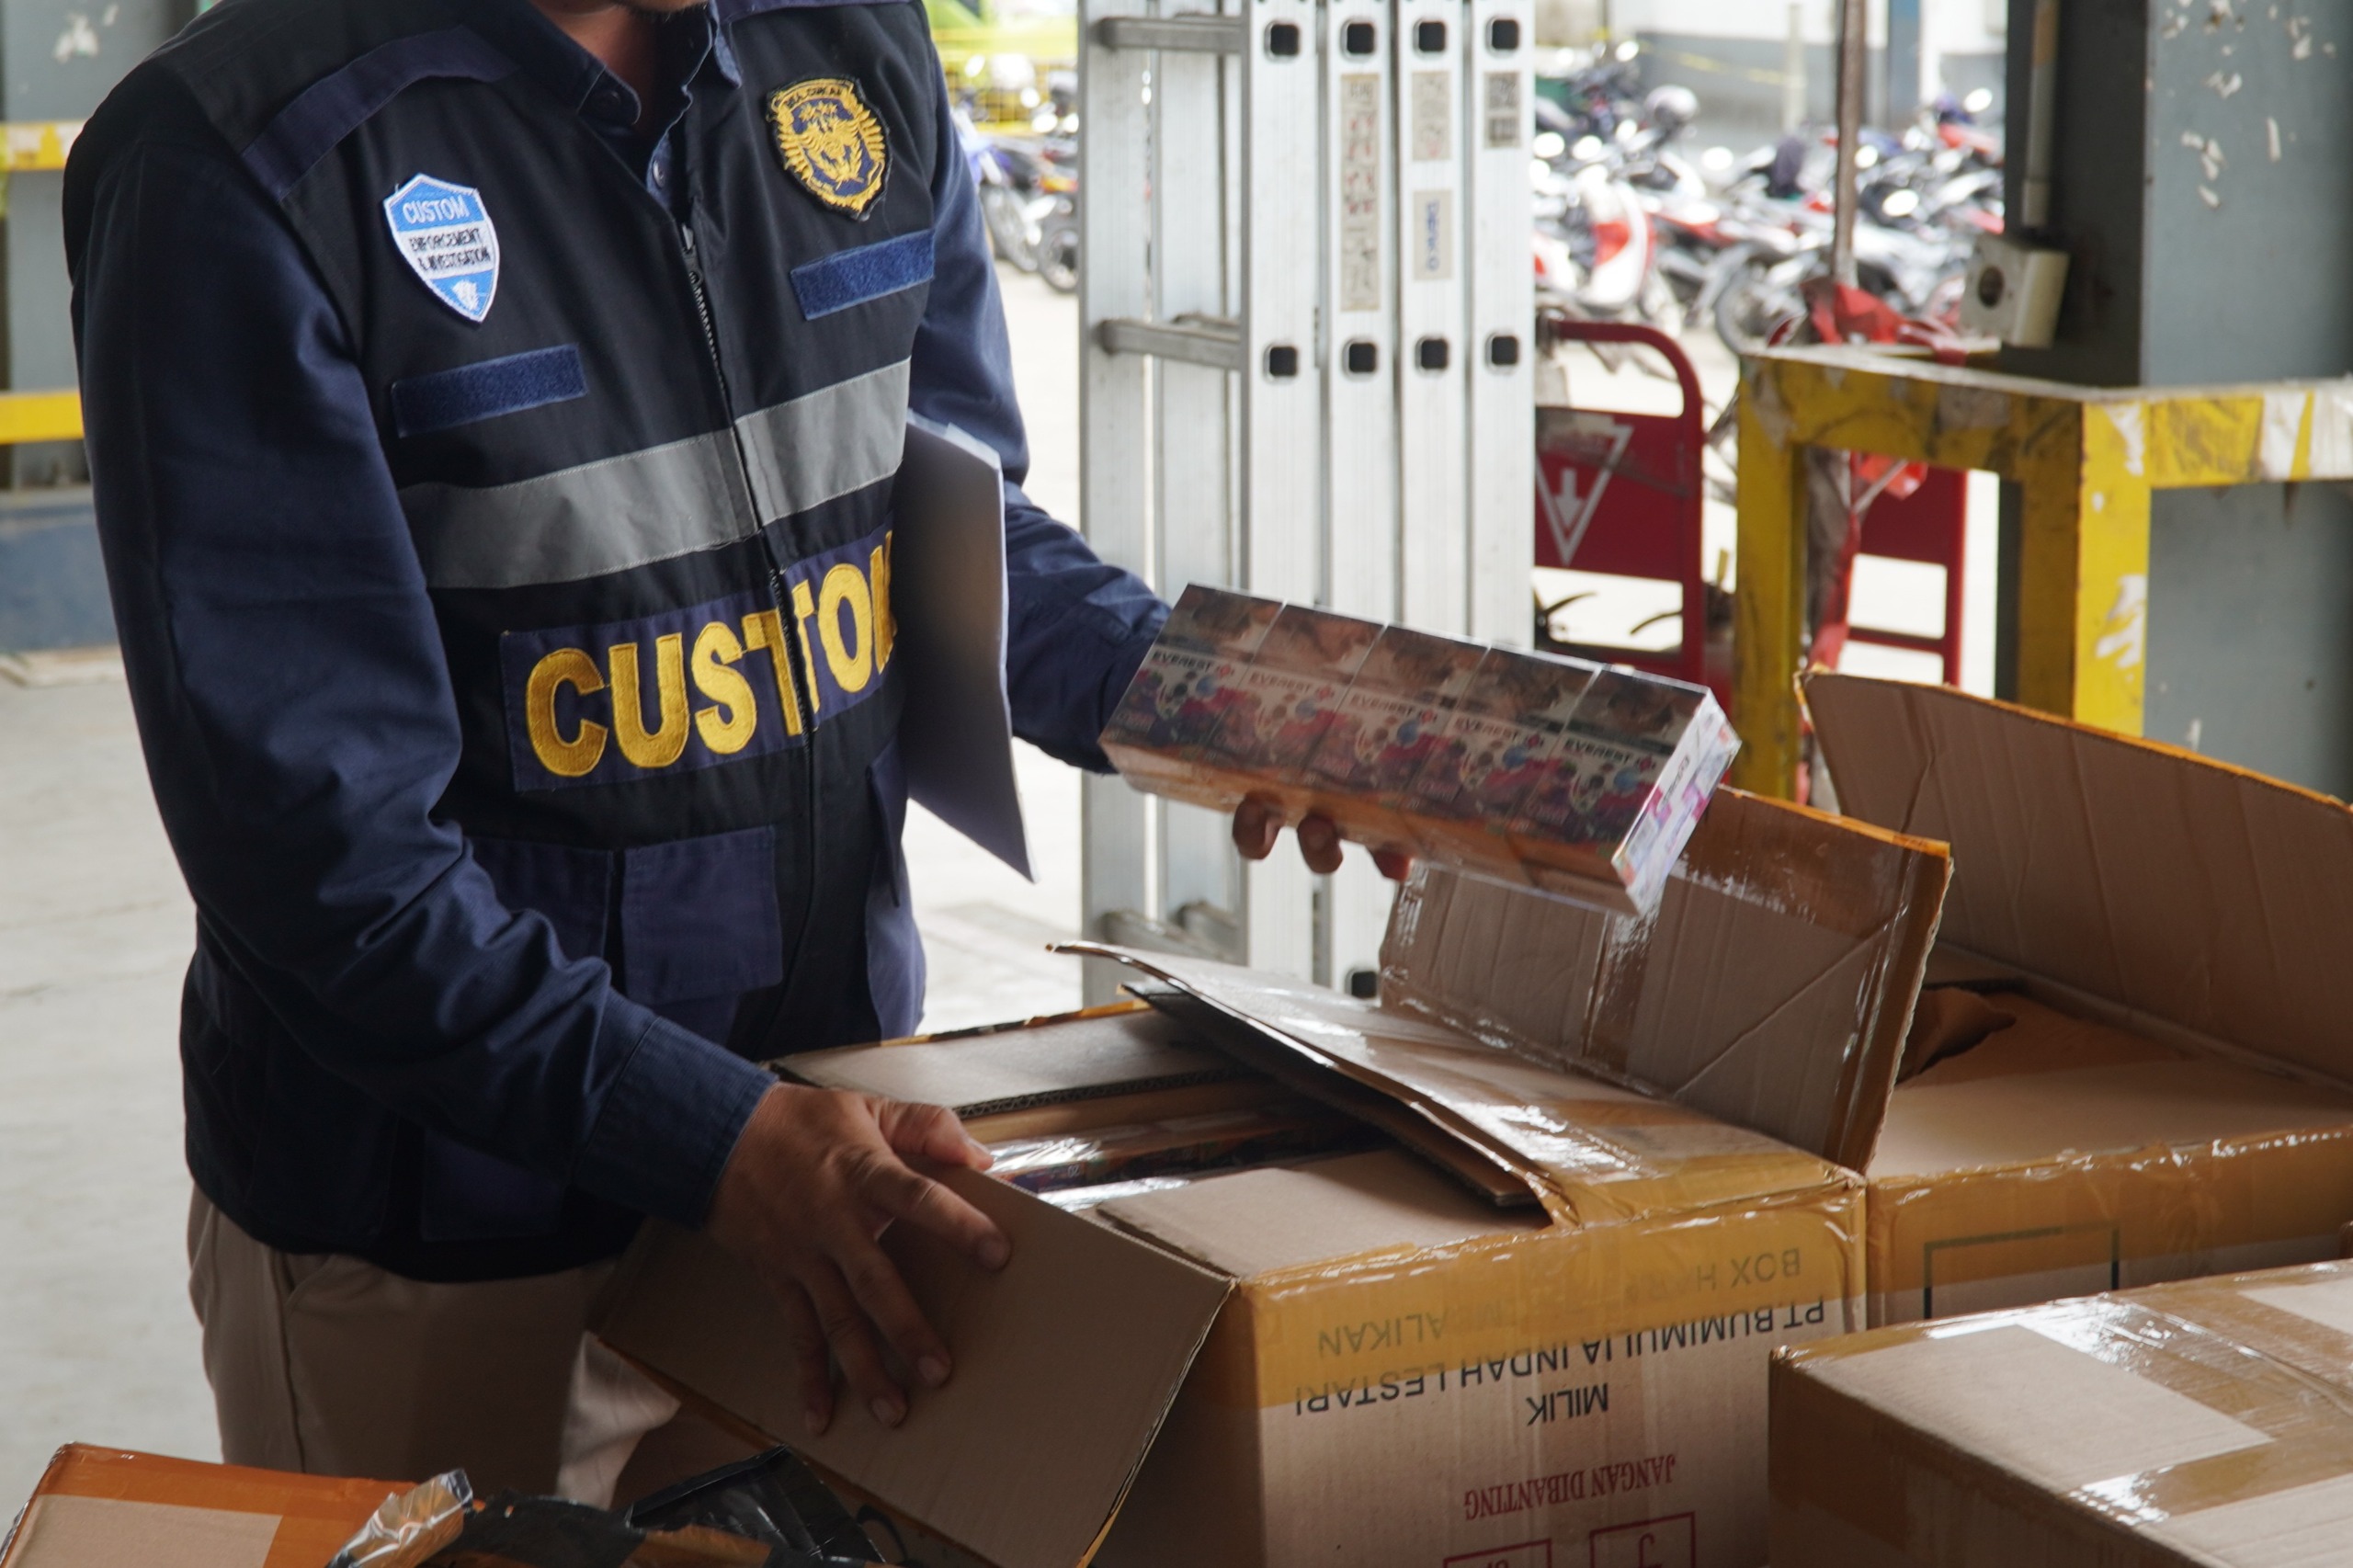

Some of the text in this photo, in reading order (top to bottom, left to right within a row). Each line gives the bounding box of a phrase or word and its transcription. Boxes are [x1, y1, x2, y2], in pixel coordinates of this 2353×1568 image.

[403, 195, 470, 223] CUSTOM
[1731, 1247, 1802, 1288] BOX
[1461, 1342, 1569, 1388] INDAH
[1296, 1362, 1446, 1416] LESTARI
[1526, 1382, 1608, 1426] MILIK
[1464, 1453, 1677, 1521] JANGAN DIBANTING
